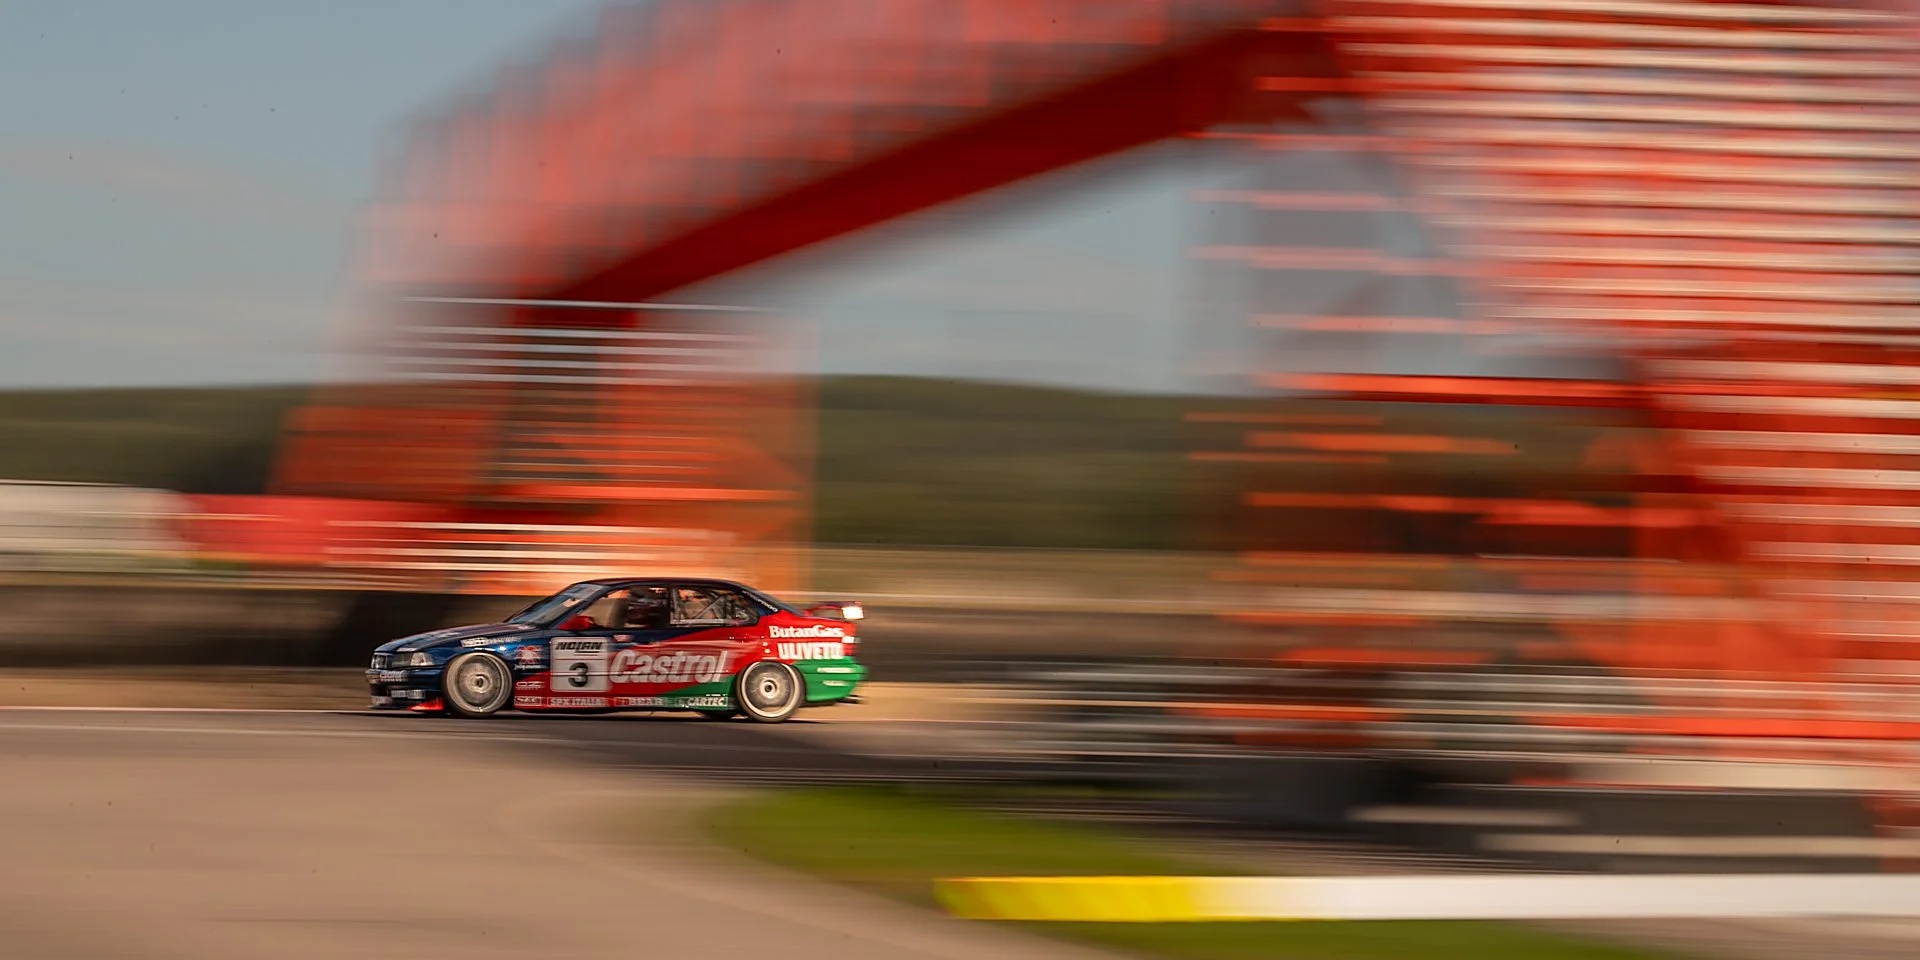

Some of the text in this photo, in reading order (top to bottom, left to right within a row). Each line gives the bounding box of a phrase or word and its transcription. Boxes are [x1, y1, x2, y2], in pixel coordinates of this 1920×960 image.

[769, 625, 845, 638] ButanGas
[555, 641, 602, 652] NOLAN
[777, 642, 845, 660] ULIVETO
[609, 649, 728, 683] Castrol
[568, 662, 589, 688] 3
[687, 697, 726, 706] CARTEC
